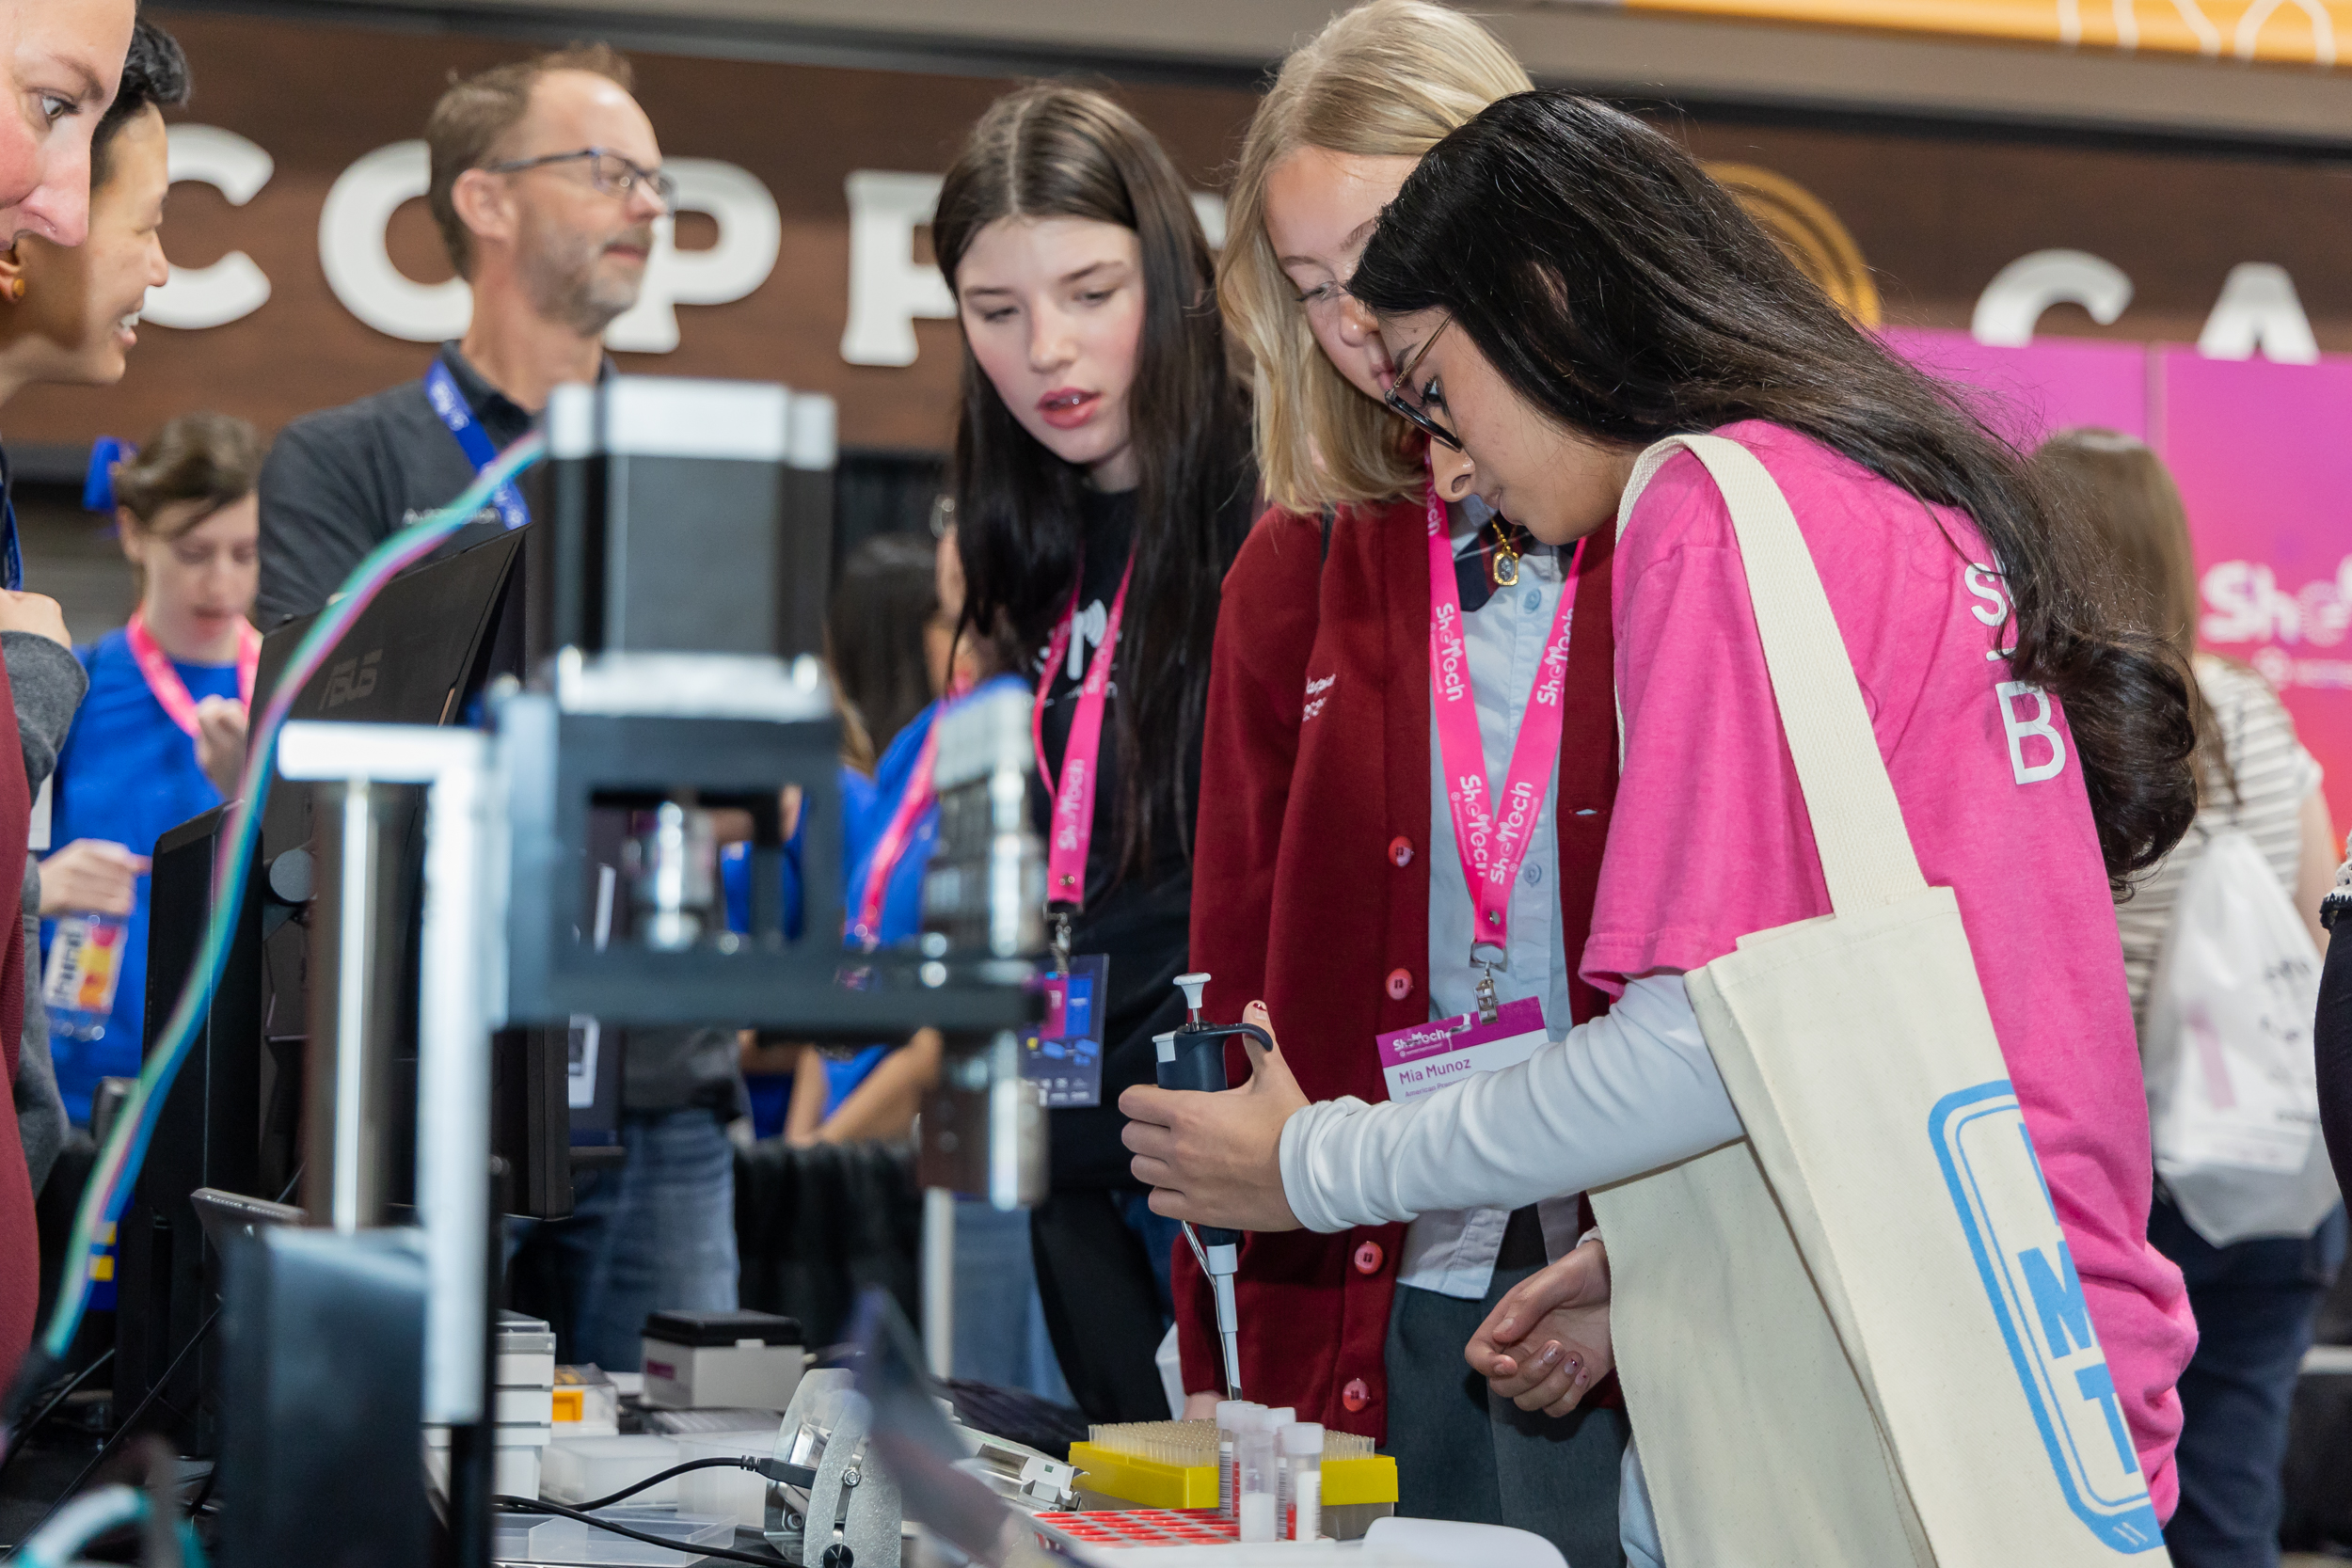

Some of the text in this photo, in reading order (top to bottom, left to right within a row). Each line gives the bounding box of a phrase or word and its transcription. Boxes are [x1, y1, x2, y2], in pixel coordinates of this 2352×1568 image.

[2199, 553, 2352, 647] She
[318, 649, 384, 711] ASUS
[1436, 602, 1466, 702] SheTech
[1489, 782, 1533, 885] SheTech
[1399, 1069, 1423, 1085] Mia
[1425, 1058, 1471, 1079] Munoz
[1405, 1085, 1437, 1098] American
